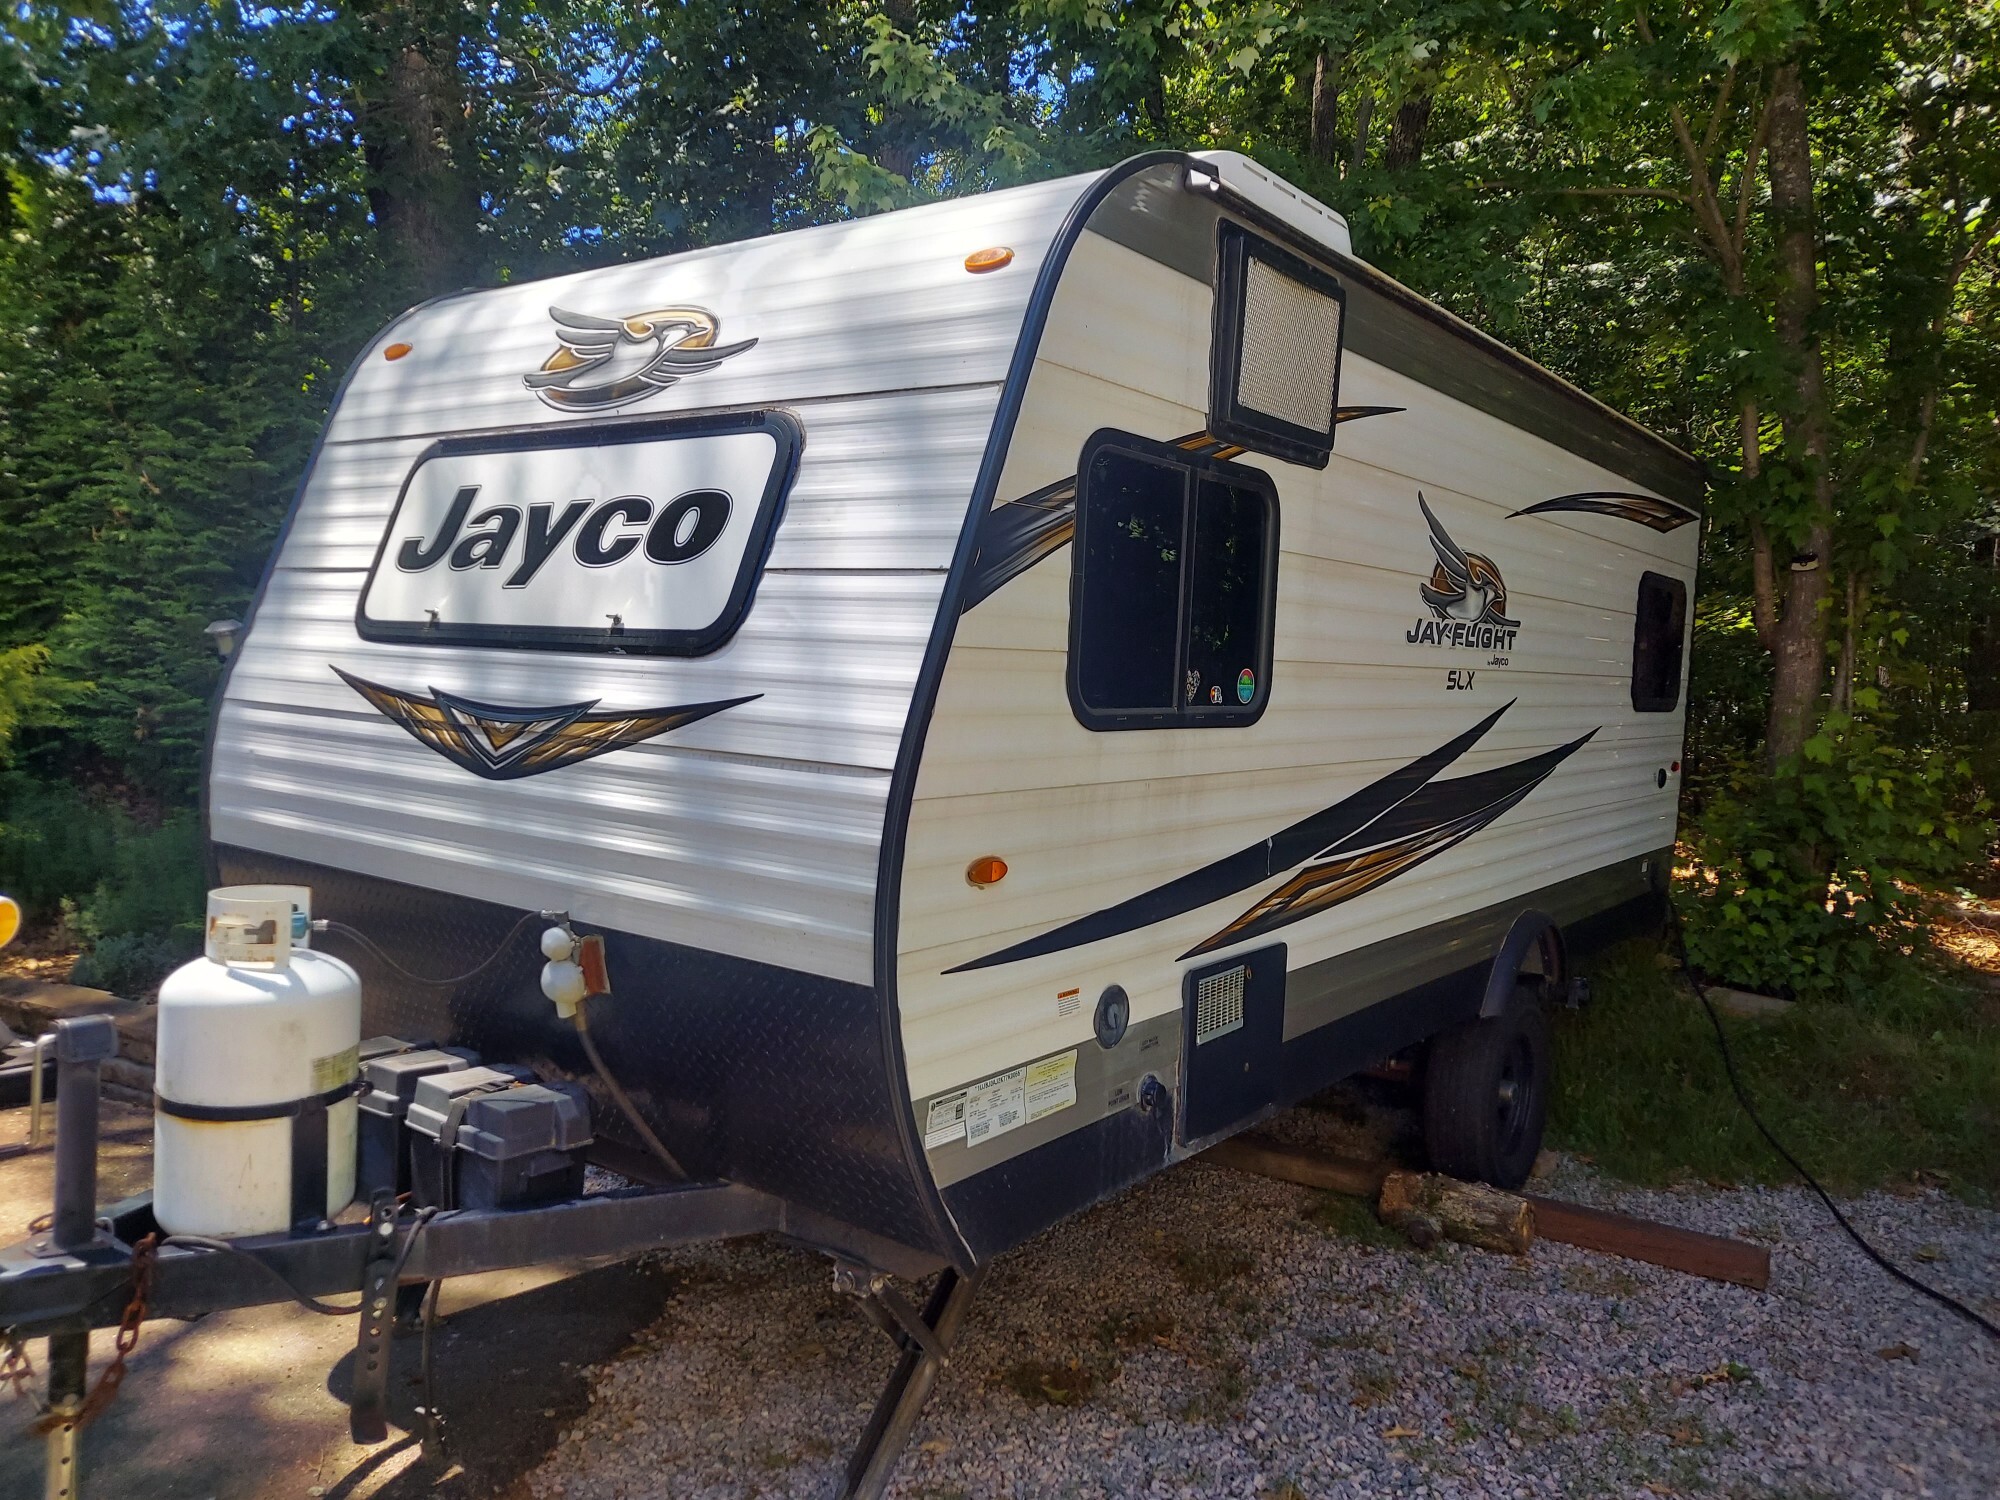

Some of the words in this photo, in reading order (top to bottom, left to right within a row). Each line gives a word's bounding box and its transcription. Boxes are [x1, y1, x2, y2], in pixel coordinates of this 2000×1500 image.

[396, 485, 733, 589] Jayco
[1490, 653, 1509, 668] Jayco
[1446, 670, 1475, 690] SLX
